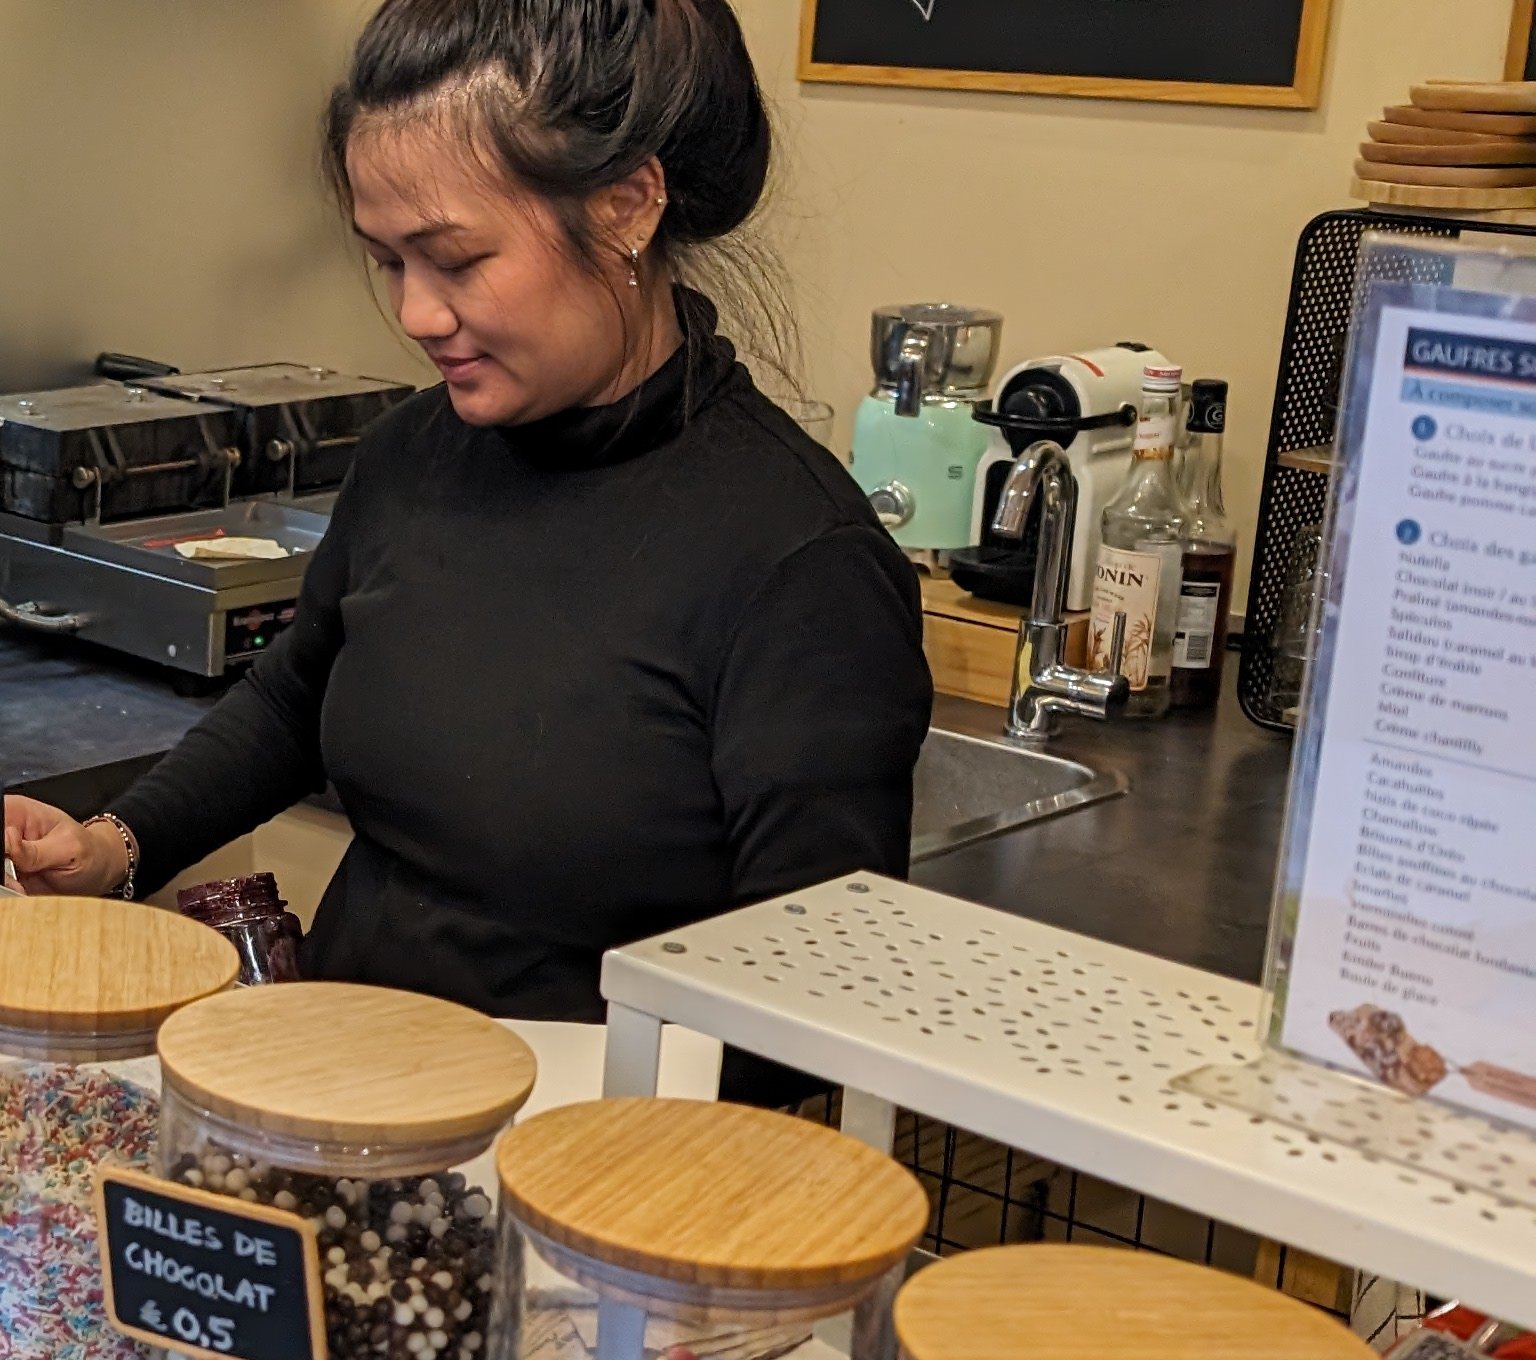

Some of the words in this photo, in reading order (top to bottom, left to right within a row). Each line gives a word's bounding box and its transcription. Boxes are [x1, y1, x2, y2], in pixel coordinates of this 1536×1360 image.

[1096, 565, 1145, 588] ONIN
[122, 1197, 223, 1251] BILLES
[233, 1230, 278, 1266] DE
[124, 1241, 276, 1313] CHOCOLAT
